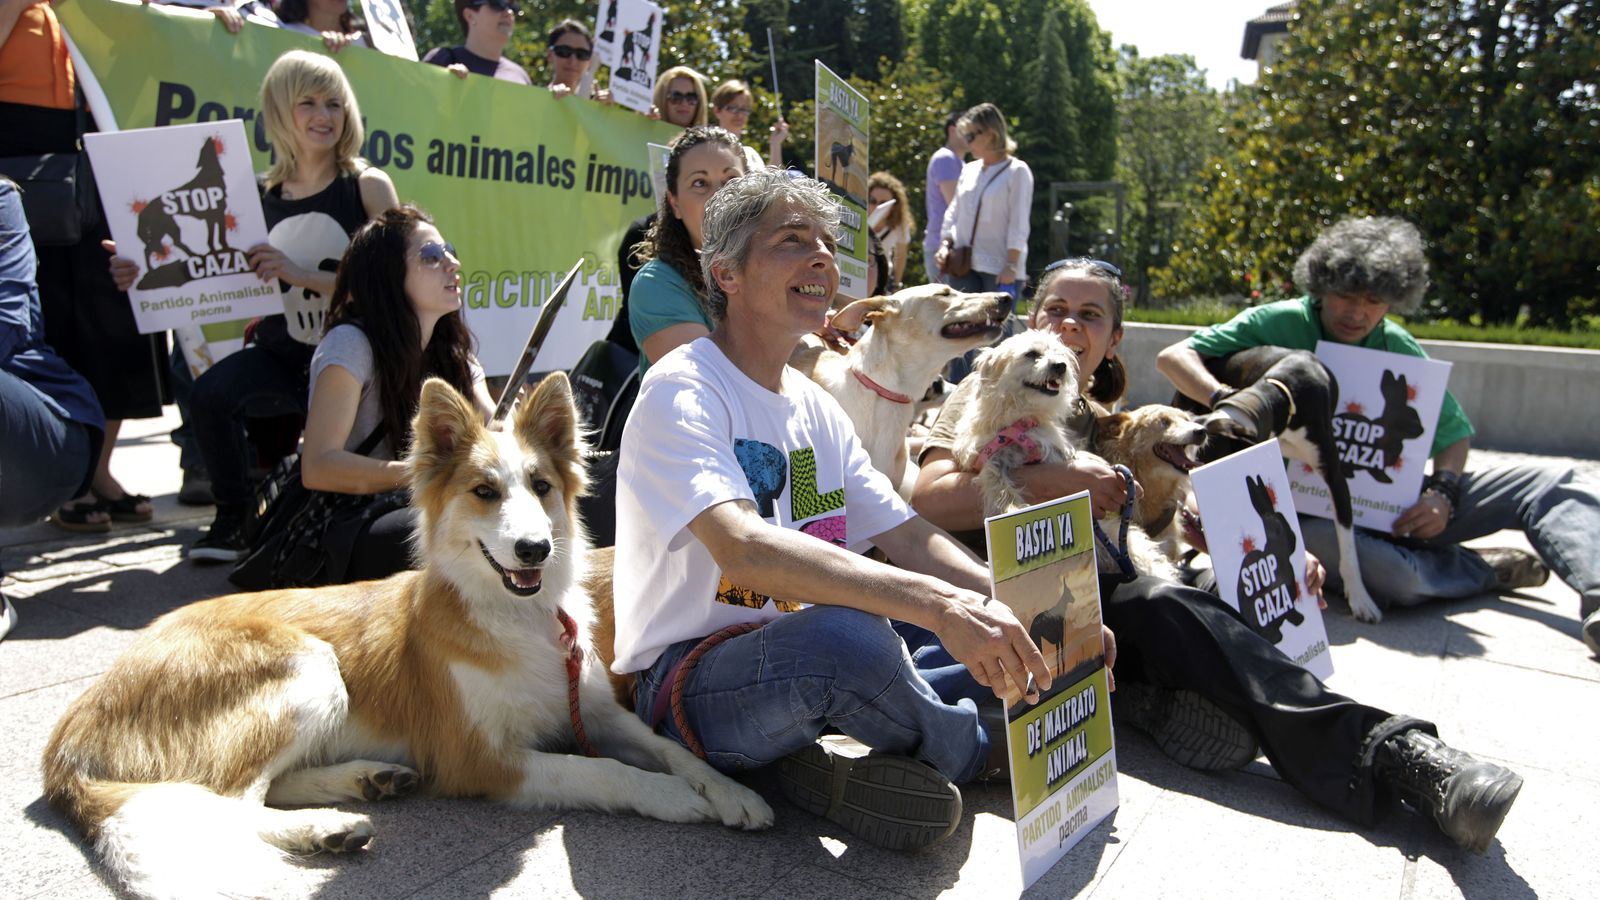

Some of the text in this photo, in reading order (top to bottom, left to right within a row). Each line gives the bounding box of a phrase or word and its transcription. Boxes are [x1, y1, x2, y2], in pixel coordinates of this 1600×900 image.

[427, 135, 576, 190] animales
[161, 187, 223, 214] STOP
[187, 251, 250, 279] CAZA
[140, 284, 274, 313] Partido Animalista
[191, 305, 232, 320] pacma
[1331, 417, 1385, 444] STOP
[1336, 441, 1384, 470] CAZA
[1290, 481, 1330, 498] Partid
[1350, 495, 1408, 515] nimalist
[1015, 512, 1074, 563] BASTA YA
[1241, 554, 1278, 597] STOP
[1254, 583, 1294, 627] CAZA
[1027, 684, 1095, 755] DE MALTRATO
[1047, 730, 1088, 785] ANIMAL
[1023, 760, 1114, 849] PARTIDO ANIMALISTA
[1059, 805, 1088, 848] pacma
